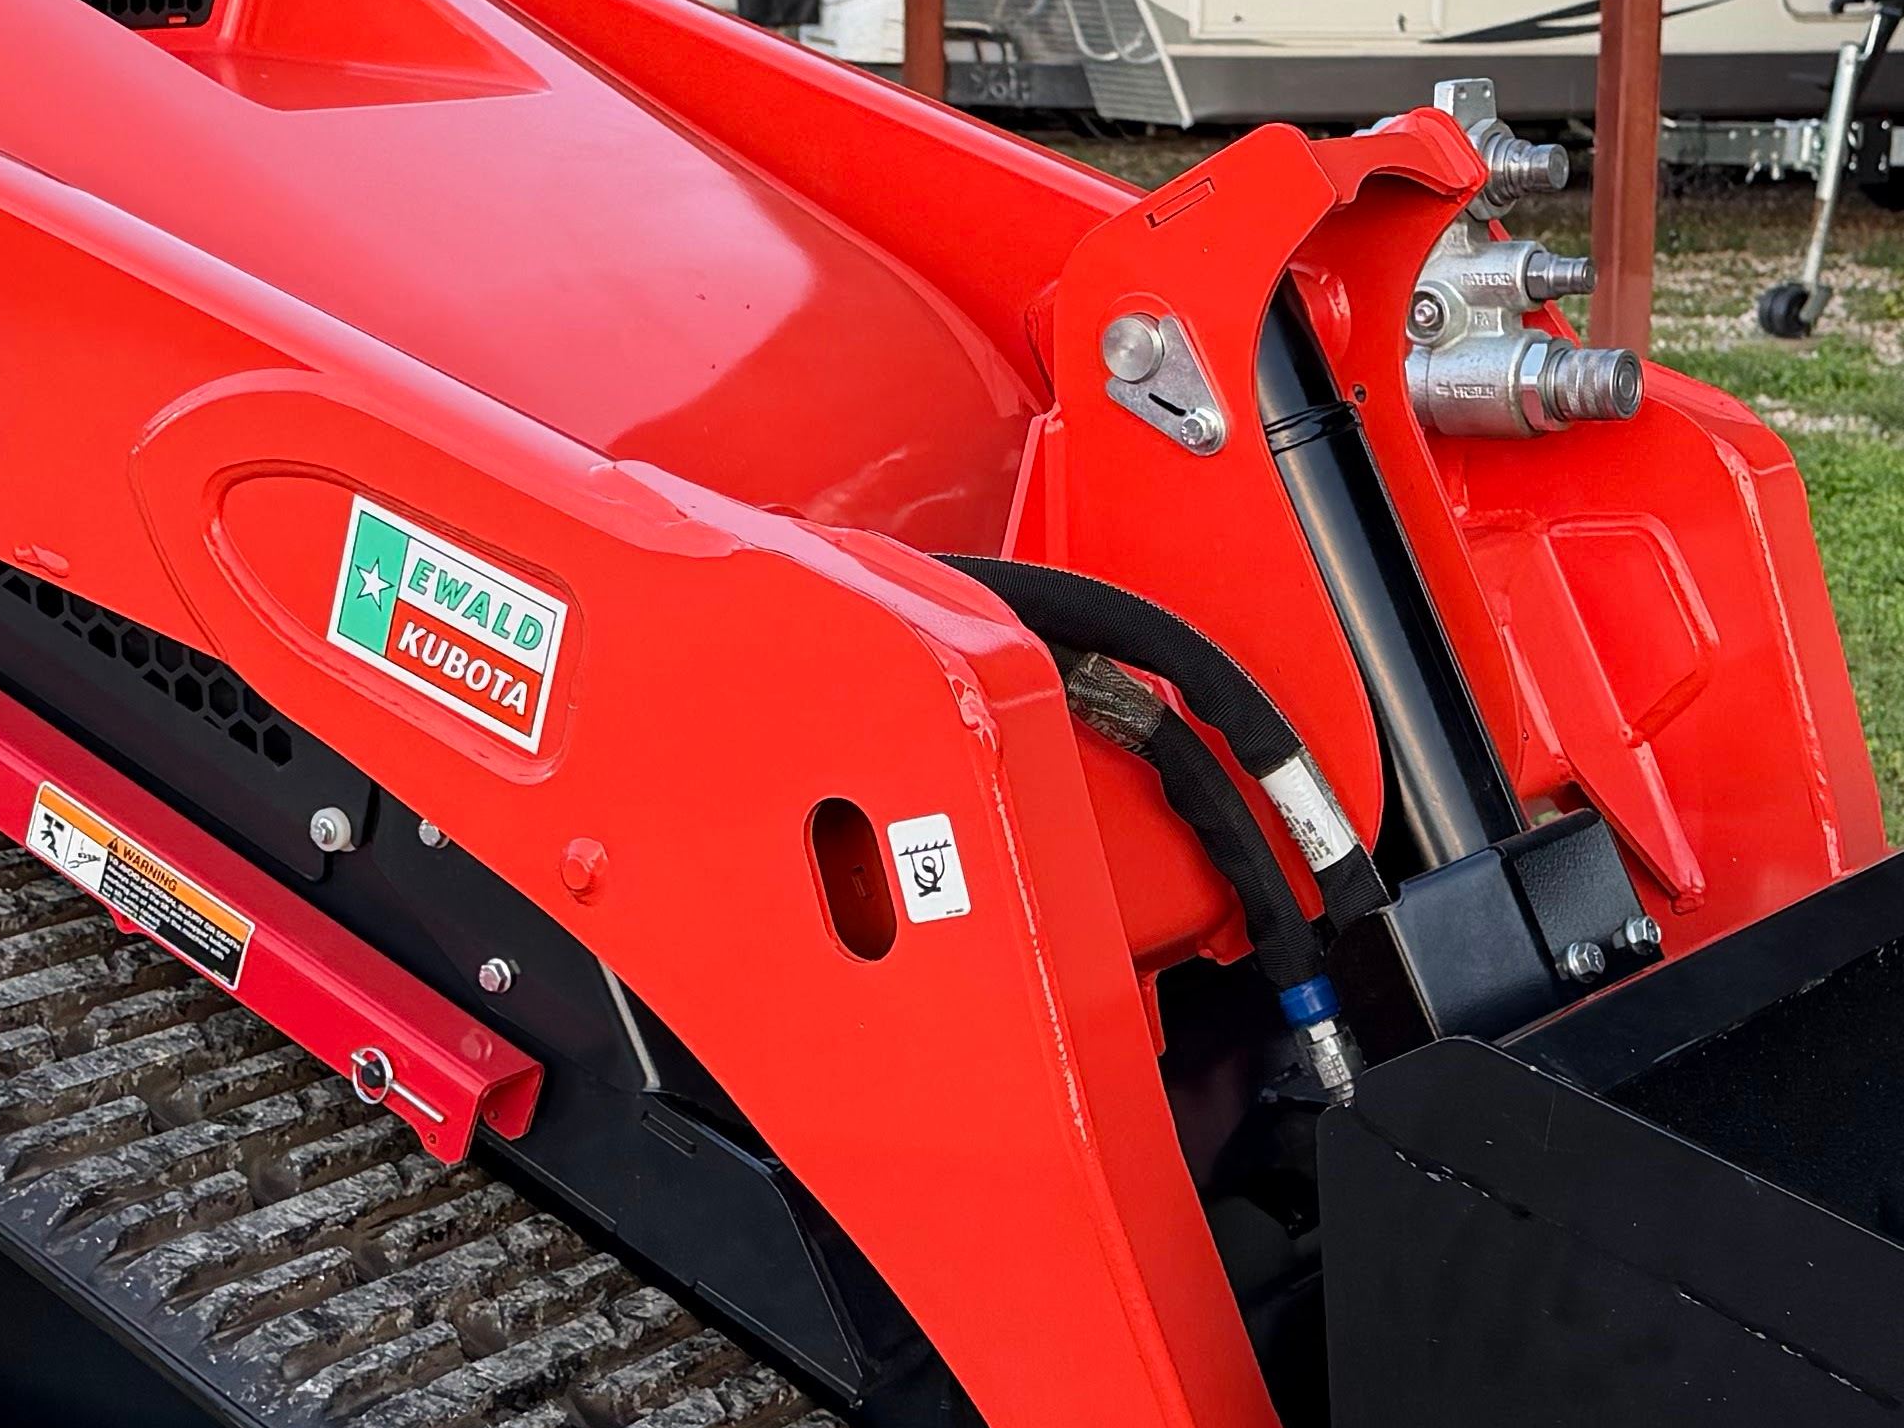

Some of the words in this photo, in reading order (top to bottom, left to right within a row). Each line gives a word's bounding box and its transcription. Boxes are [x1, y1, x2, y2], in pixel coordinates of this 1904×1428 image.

[408, 558, 544, 651] EWALD
[397, 621, 528, 716] KUBOTA
[123, 846, 178, 892] WARNING
